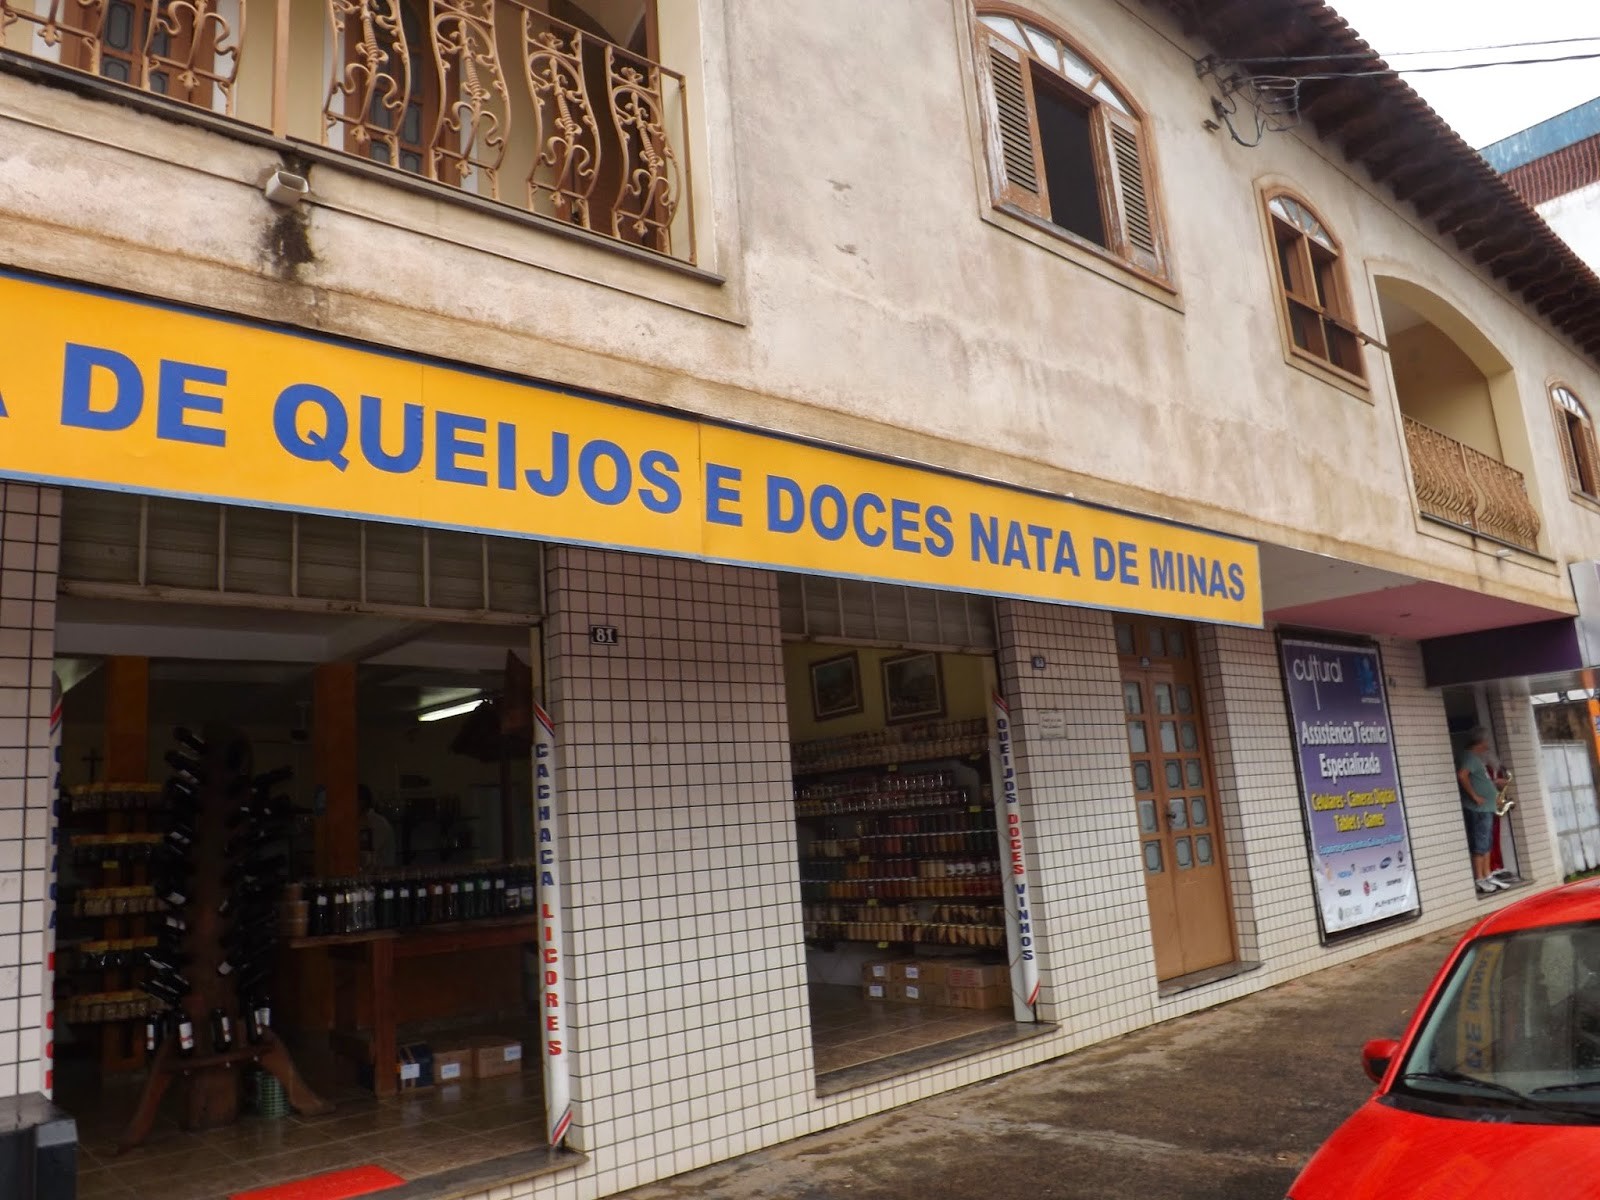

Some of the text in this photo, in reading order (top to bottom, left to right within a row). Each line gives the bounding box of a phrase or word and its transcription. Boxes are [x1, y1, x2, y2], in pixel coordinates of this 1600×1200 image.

[60, 342, 227, 447] DE
[273, 383, 682, 513] QUEIJOS
[705, 463, 742, 527] E
[767, 475, 954, 557] DOCES
[970, 513, 1080, 577] NATA
[1093, 537, 1139, 585] DE
[1150, 547, 1245, 602] MINAS
[596, 628, 614, 642] 81
[1302, 721, 1387, 745] Assistência Técnica
[1320, 753, 1380, 783] Especializada
[535, 743, 562, 1056] CACHACA LICORES
[997, 719, 1034, 961] QUEIJOS DOCES VINHOS
